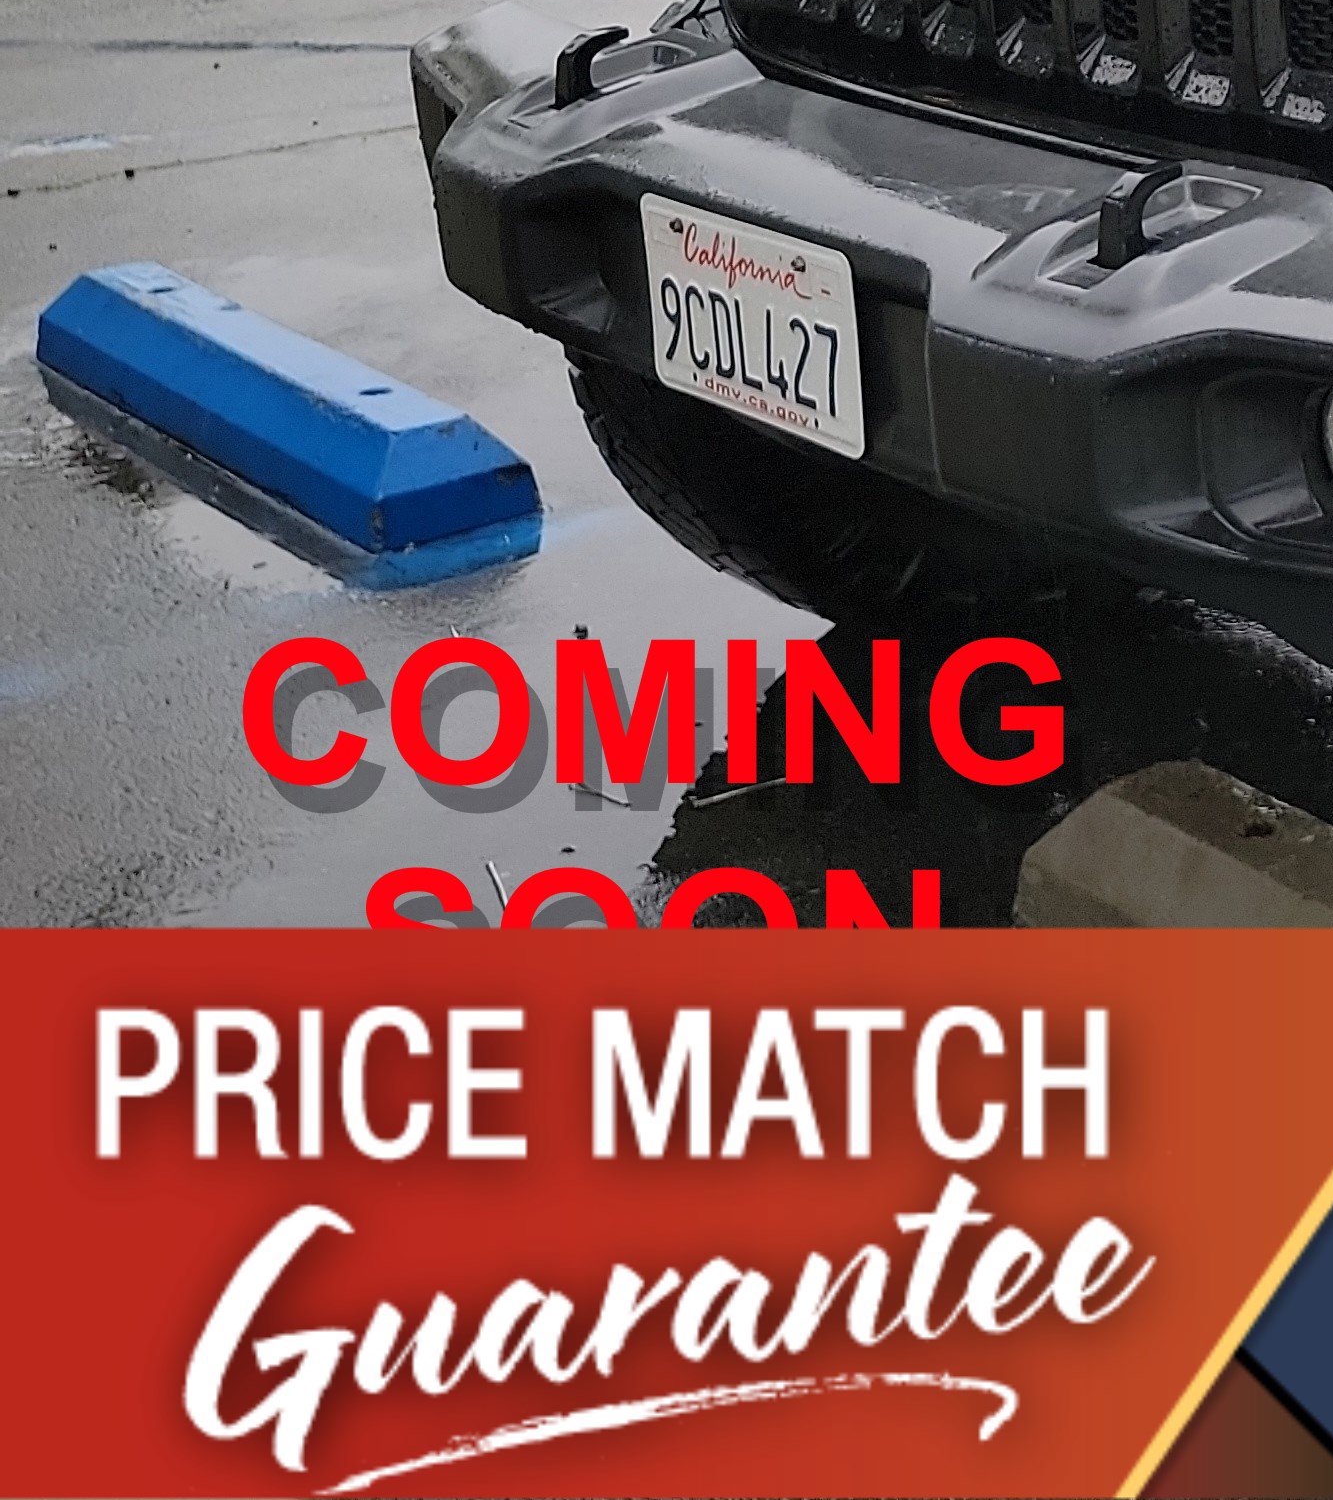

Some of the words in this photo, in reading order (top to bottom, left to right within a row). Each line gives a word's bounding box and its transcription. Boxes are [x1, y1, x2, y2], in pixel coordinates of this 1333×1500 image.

[683, 221, 813, 300] California
[660, 276, 838, 418] 9CDL427
[704, 376, 809, 428] dmv.ca.gov
